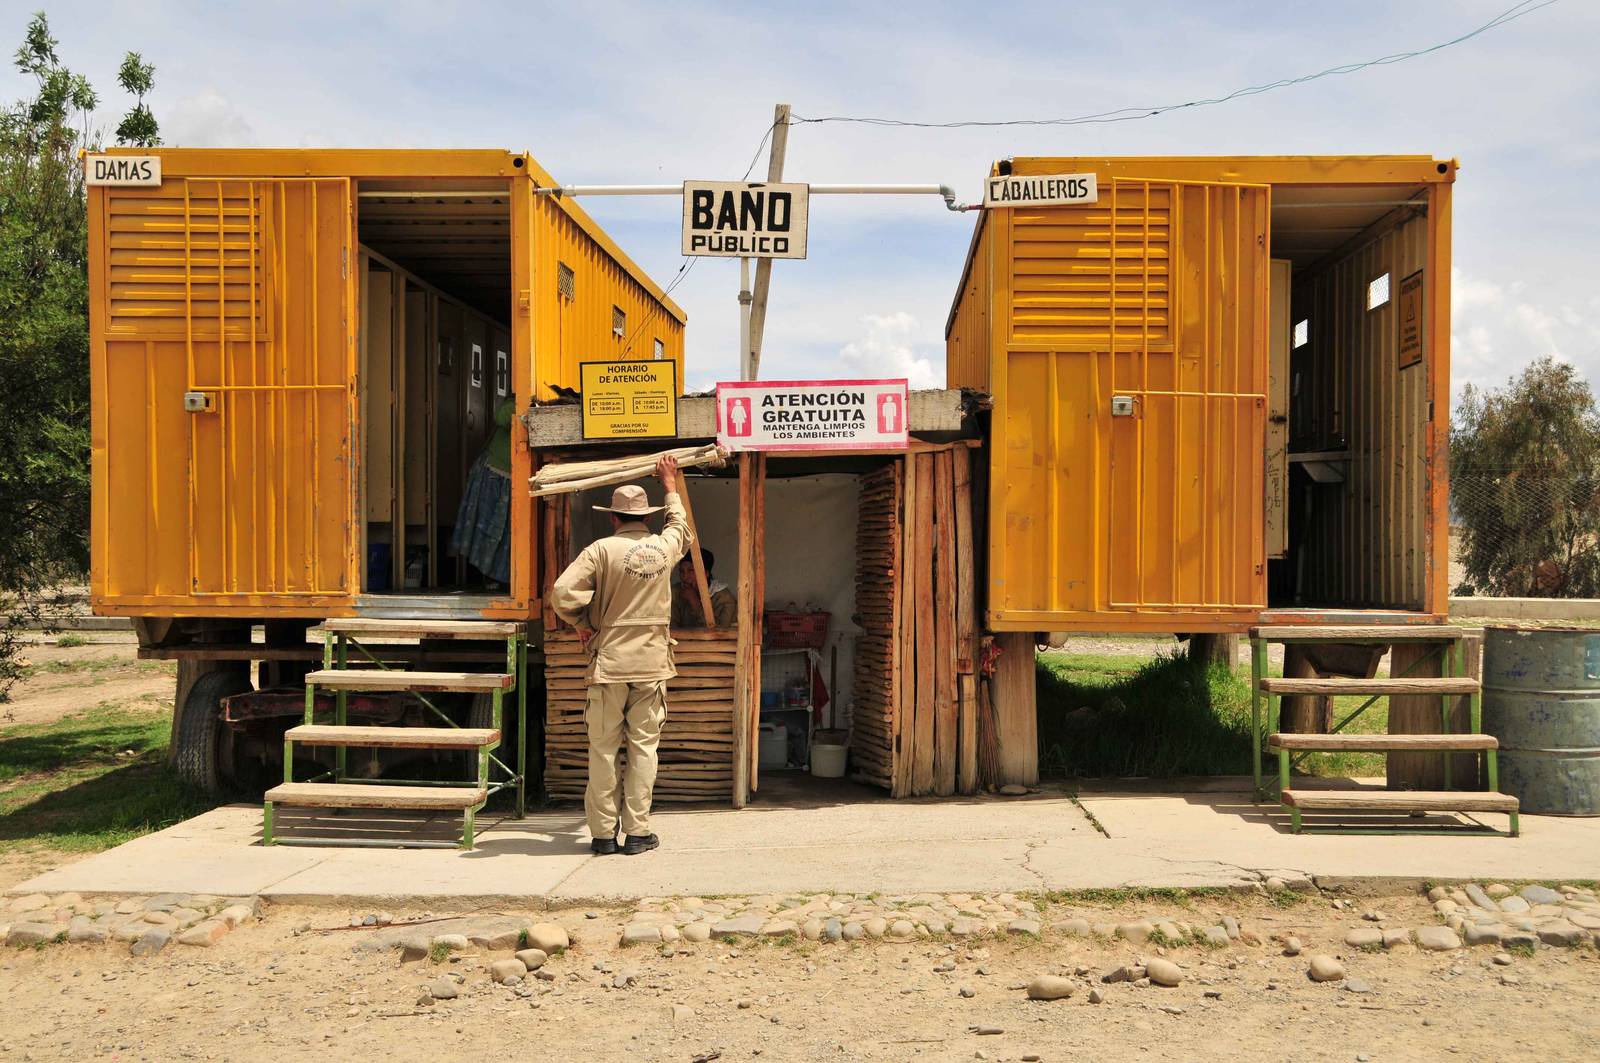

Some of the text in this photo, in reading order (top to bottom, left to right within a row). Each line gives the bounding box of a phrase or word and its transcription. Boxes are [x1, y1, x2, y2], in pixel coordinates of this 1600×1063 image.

[95, 160, 152, 180] DAMAS
[990, 179, 1088, 202] CABALLEROS
[692, 184, 792, 232] BAÑO
[607, 365, 648, 373] HORARIO
[599, 373, 657, 384] DE ATENCIÓN
[761, 390, 865, 407] ATENCIÓN
[762, 409, 866, 423] GRATUITA
[763, 422, 865, 431] MANTENGA LIMPIOS
[795, 430, 855, 439] AMBIENTES
